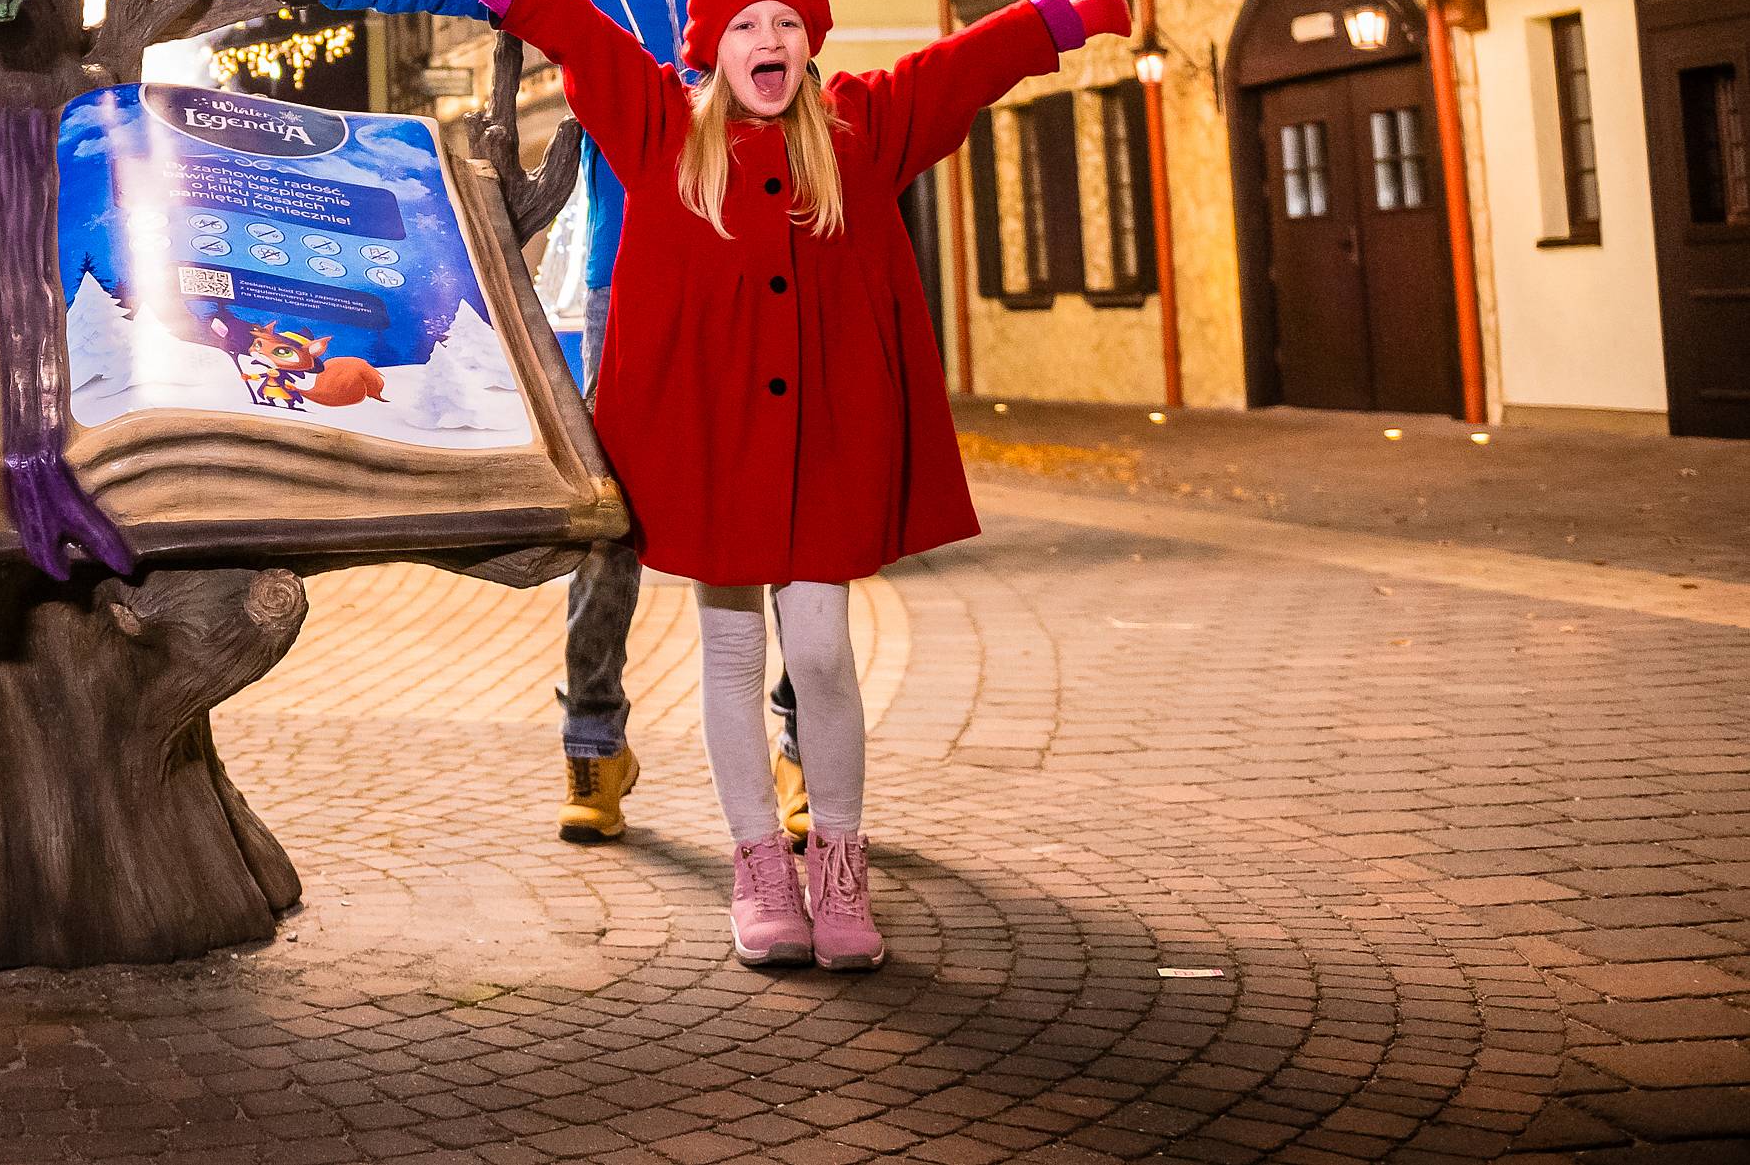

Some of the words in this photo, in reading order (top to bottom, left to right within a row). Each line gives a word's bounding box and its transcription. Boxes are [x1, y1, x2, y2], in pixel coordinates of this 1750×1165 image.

[211, 101, 271, 118] Winter
[163, 170, 215, 181] bawić
[220, 177, 243, 188] się
[248, 181, 350, 206] bezpiecznie
[192, 165, 279, 185] zachować
[284, 180, 345, 197] radość,
[208, 183, 249, 197] kilku
[169, 189, 248, 207] pamiętaj
[253, 200, 350, 225] koniecznie!
